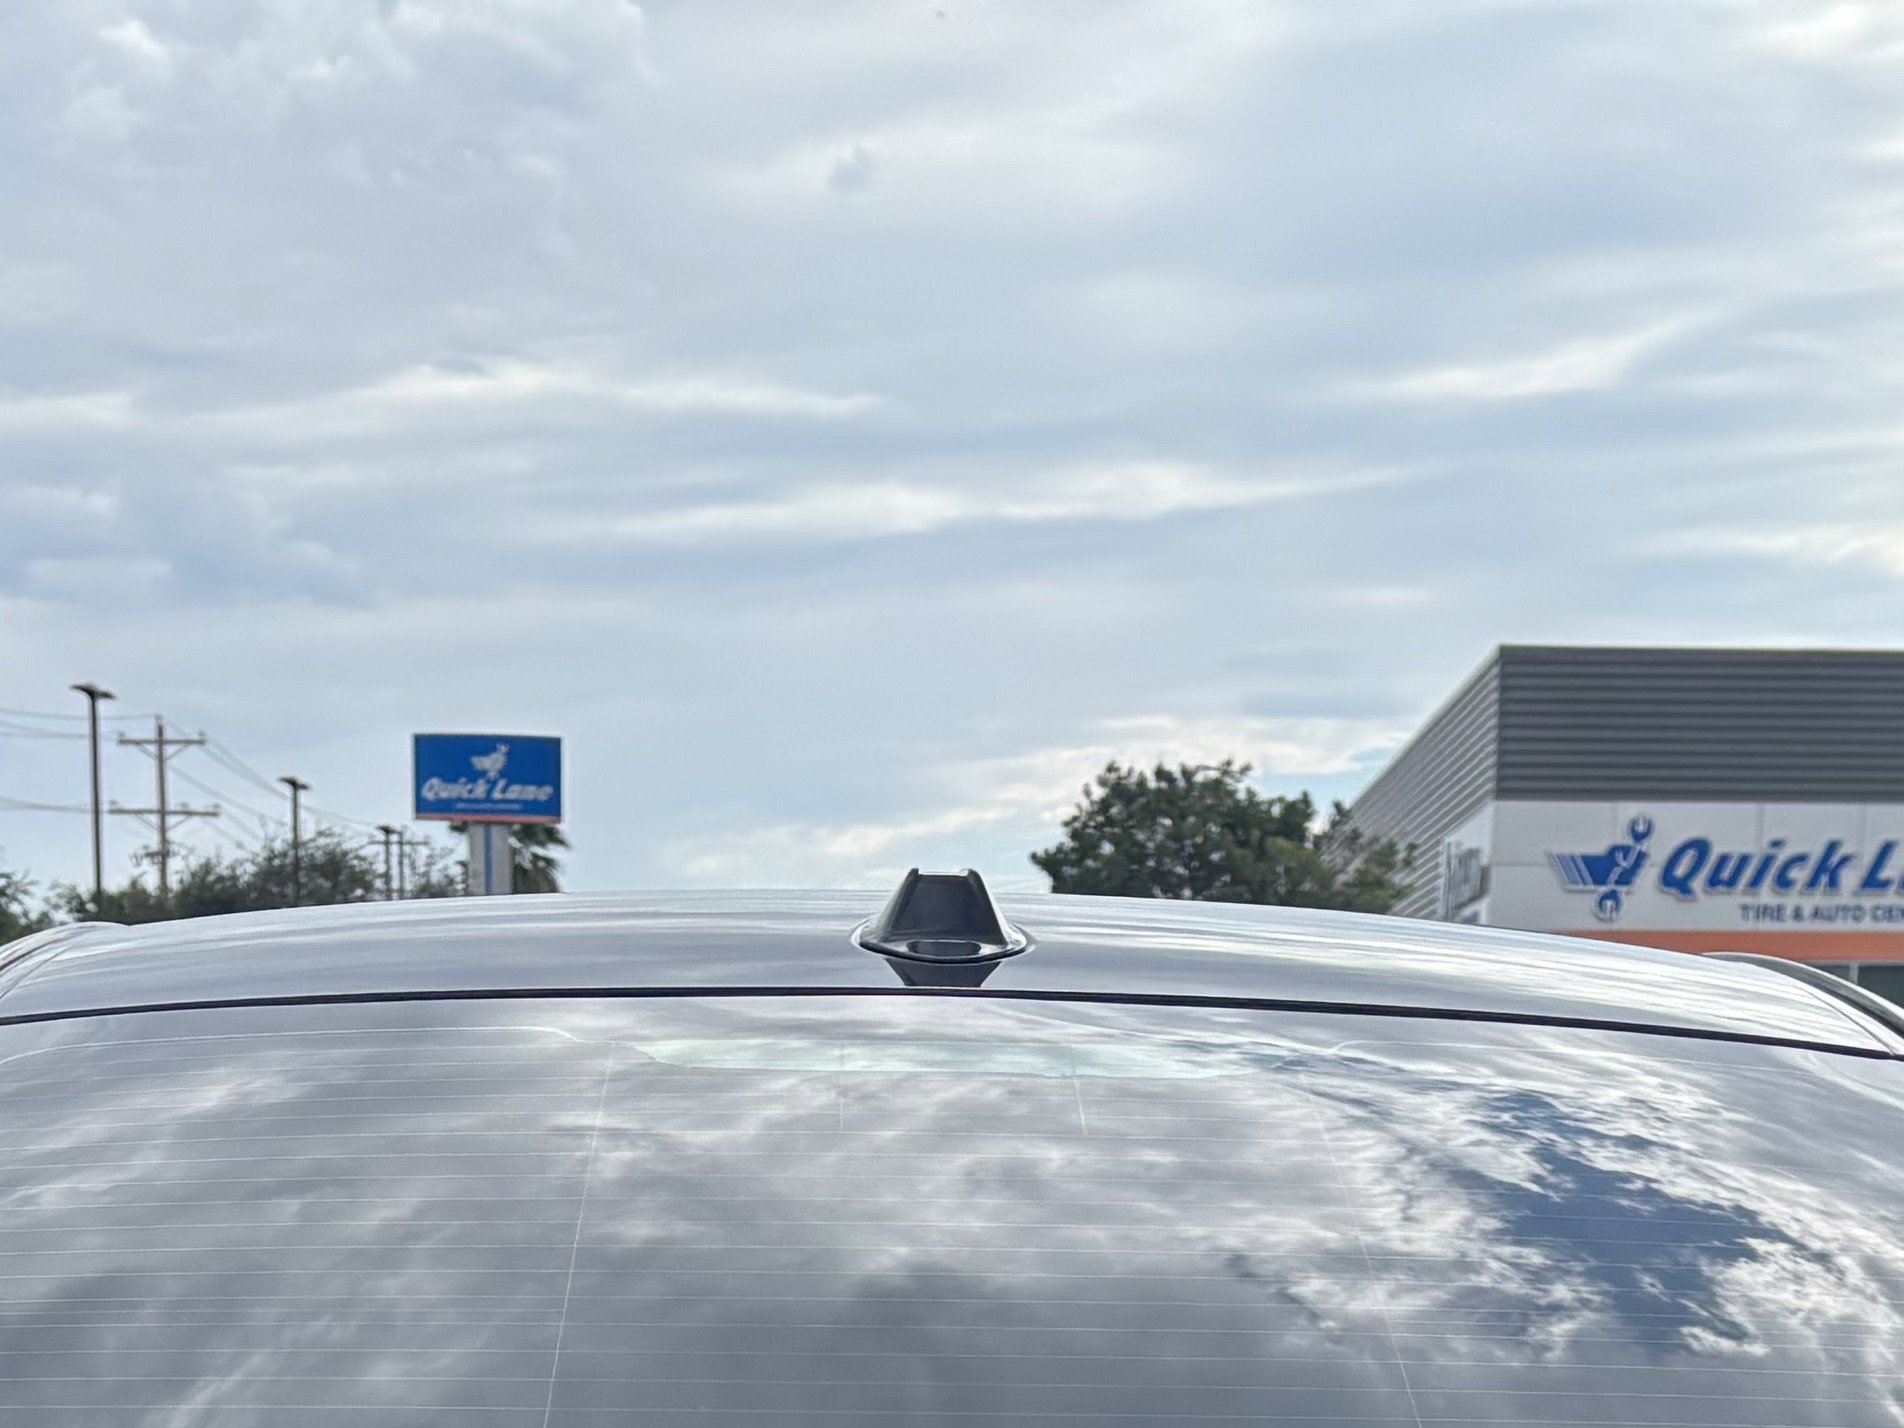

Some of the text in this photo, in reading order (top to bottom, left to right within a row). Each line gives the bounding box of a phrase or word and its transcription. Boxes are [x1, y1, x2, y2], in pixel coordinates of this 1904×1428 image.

[421, 777, 554, 802] Quick Lane
[1660, 837, 1854, 899] Quick
[1740, 903, 1787, 922] TIRE
[1792, 904, 1804, 922] &
[1810, 903, 1867, 923] AUTO
